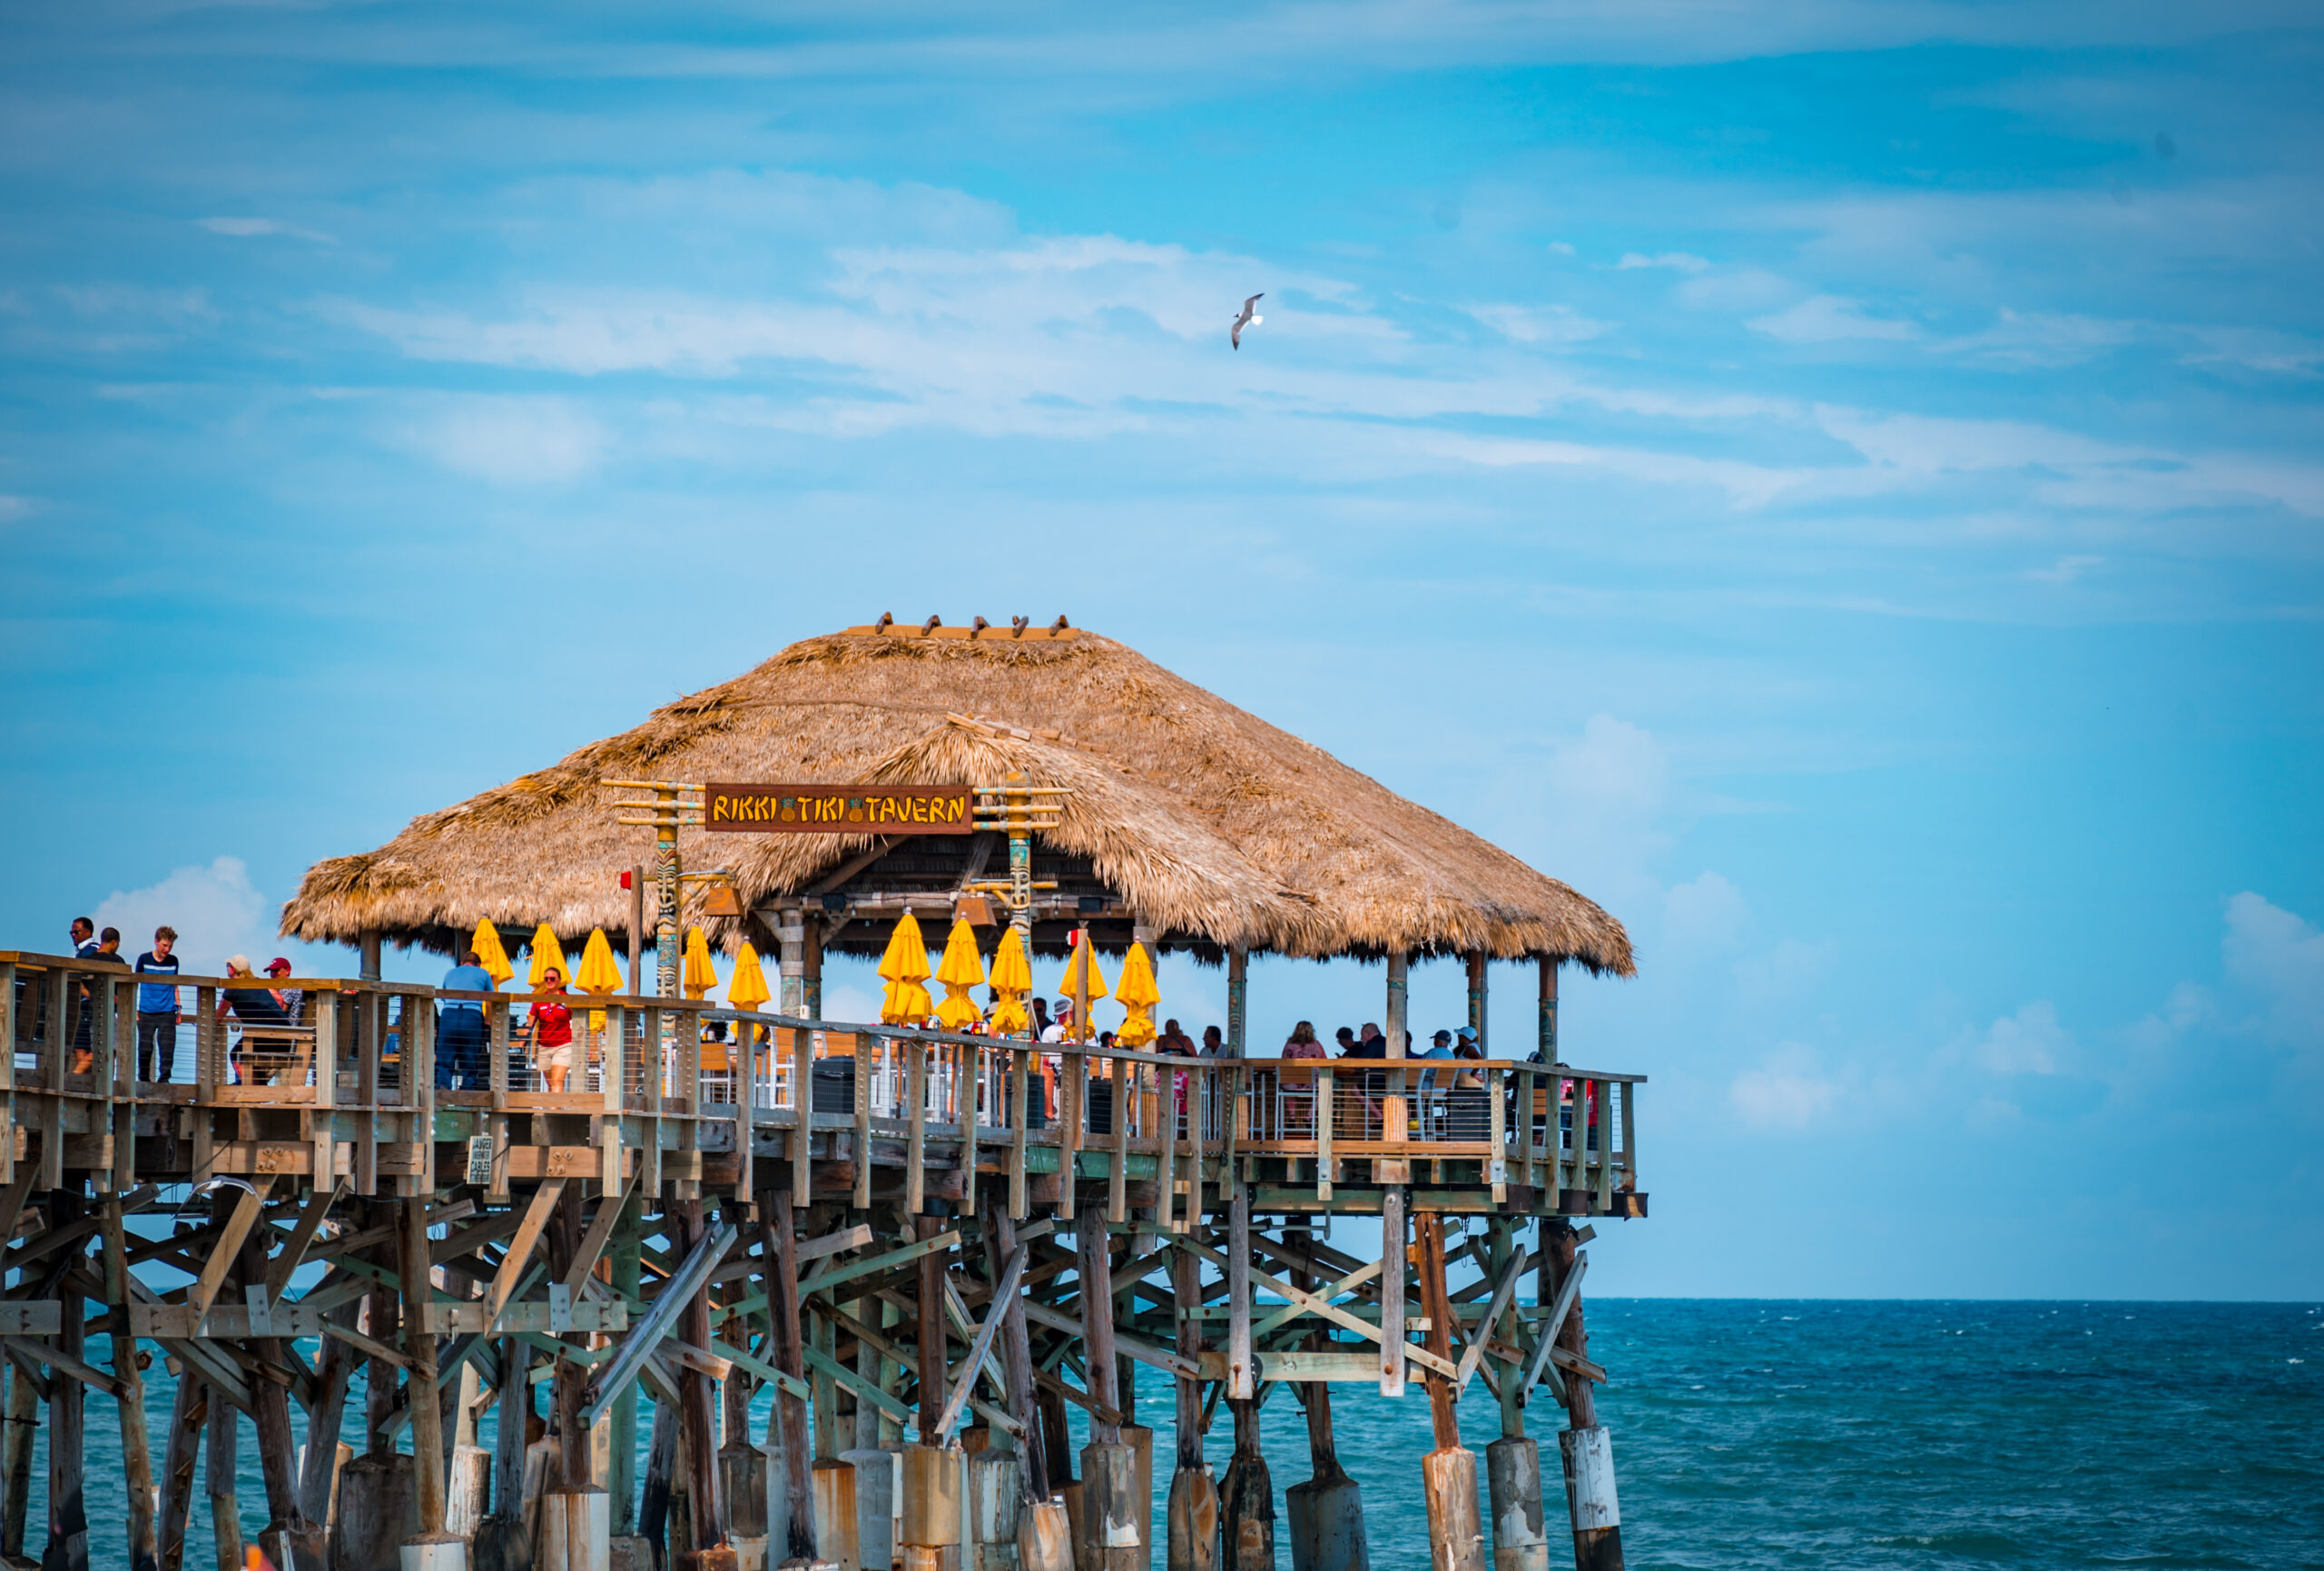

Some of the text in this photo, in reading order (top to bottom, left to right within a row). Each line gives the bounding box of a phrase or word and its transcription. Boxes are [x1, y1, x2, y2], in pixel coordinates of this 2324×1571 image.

[713, 795, 965, 823] RIKKI TIKI TAVERN
